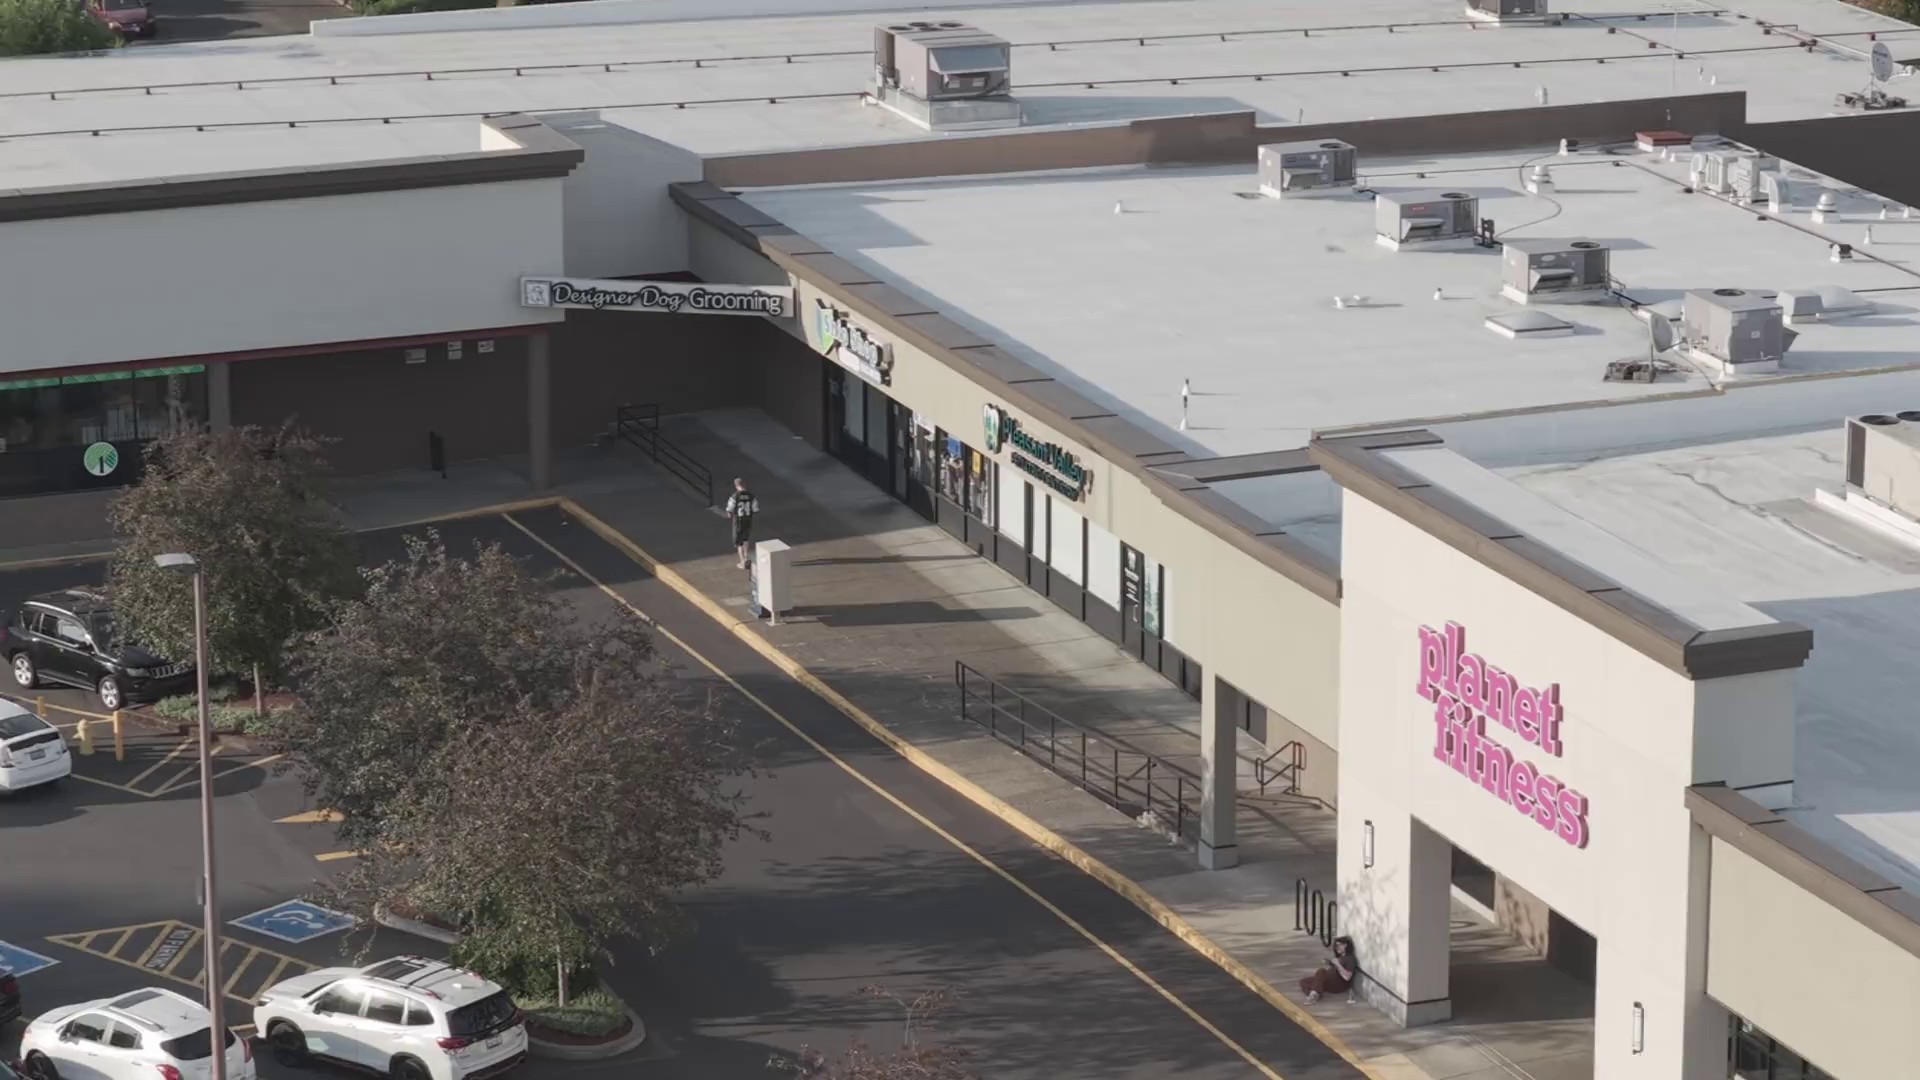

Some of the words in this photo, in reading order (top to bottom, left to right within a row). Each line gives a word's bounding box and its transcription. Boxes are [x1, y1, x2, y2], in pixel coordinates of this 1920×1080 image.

[551, 282, 636, 309] Designer
[640, 286, 684, 312] Dog
[689, 288, 784, 316] Grooming
[1002, 415, 1051, 465] Pleasant
[1050, 443, 1087, 487] Valley
[1416, 620, 1563, 757] planet
[1434, 695, 1589, 850] fitness
